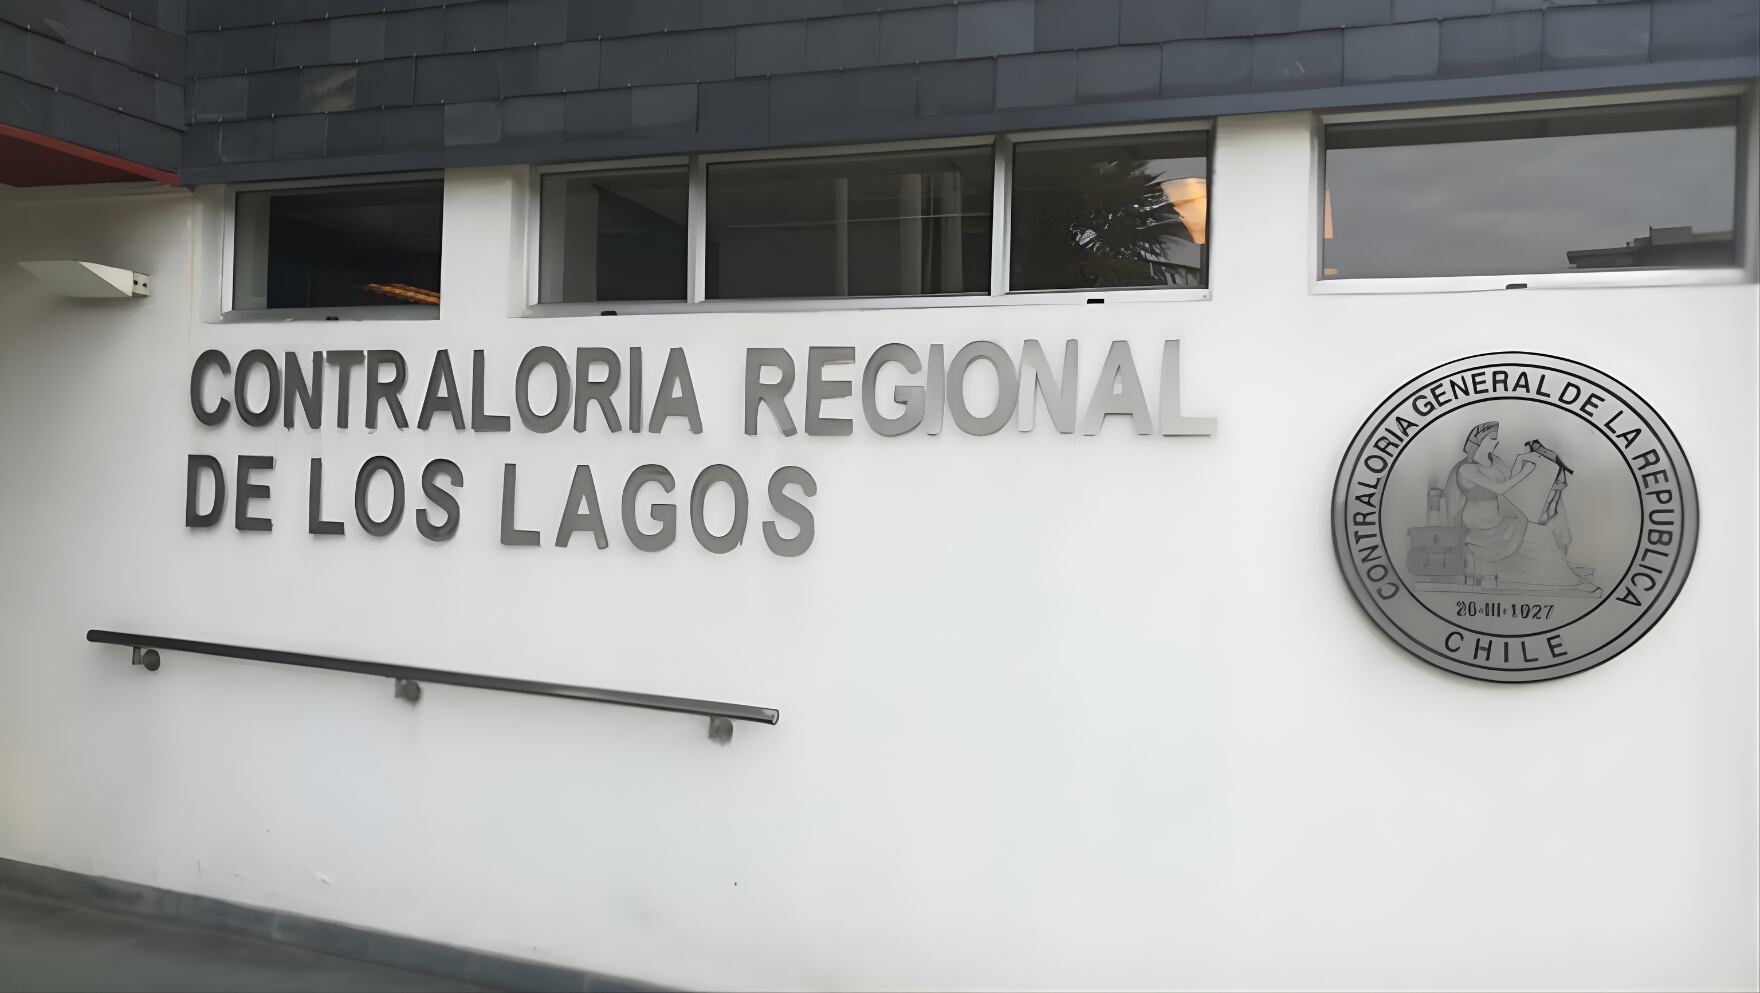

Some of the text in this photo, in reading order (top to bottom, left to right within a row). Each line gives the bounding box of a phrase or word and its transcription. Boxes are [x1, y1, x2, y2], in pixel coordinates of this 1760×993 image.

[190, 338, 1218, 437] CONTRALORIA REGIONAL
[186, 454, 818, 557] DE LOS LAGOS
[1353, 370, 1676, 608] CONTRALORIA GENERAL DE LA REPUBLICA
[1444, 631, 1568, 663] CHILE
